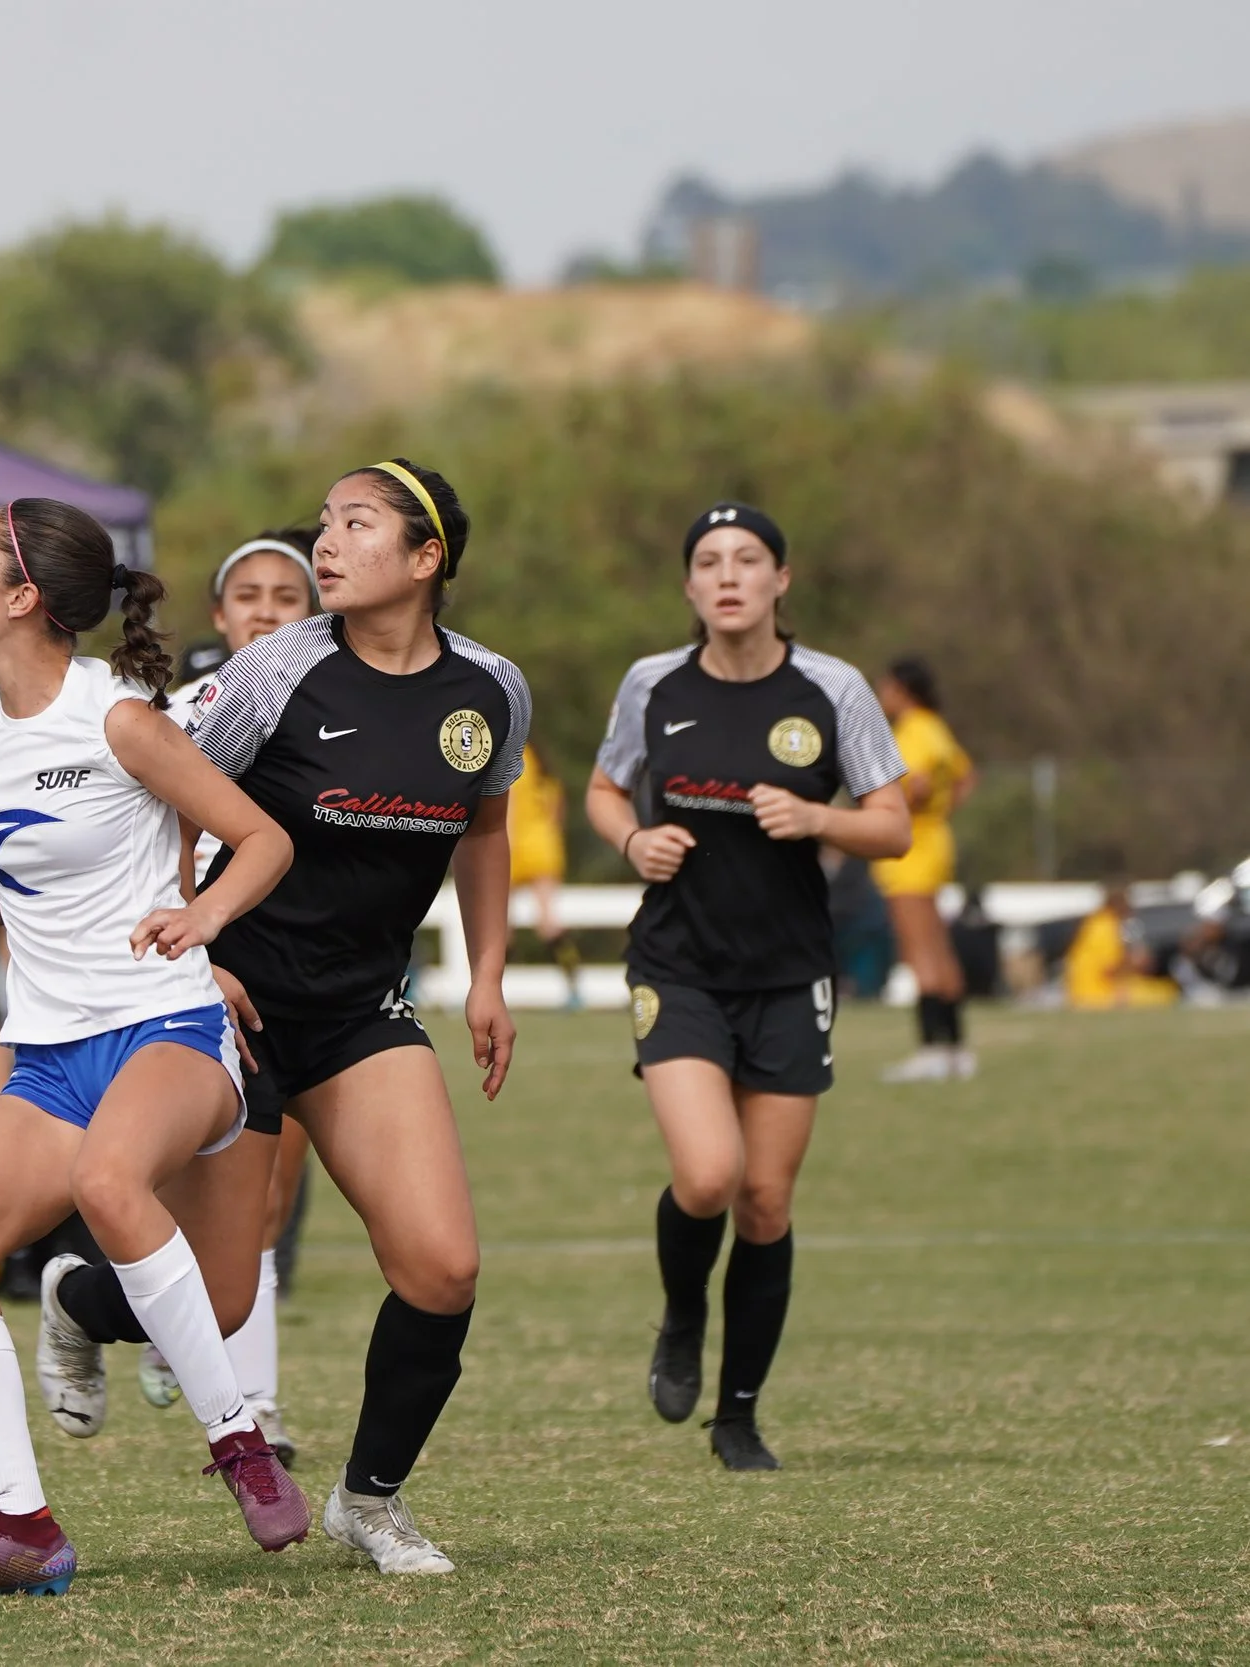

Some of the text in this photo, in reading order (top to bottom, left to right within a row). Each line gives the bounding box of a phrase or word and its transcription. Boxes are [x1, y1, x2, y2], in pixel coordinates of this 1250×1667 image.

[445, 712, 487, 731] SOCAL ELITE
[443, 744, 490, 771] FOOTBALL CLUB
[35, 769, 91, 791] SURF
[317, 788, 468, 820] California
[313, 804, 468, 835] TRANSMISSION
[811, 976, 833, 1033] 9
